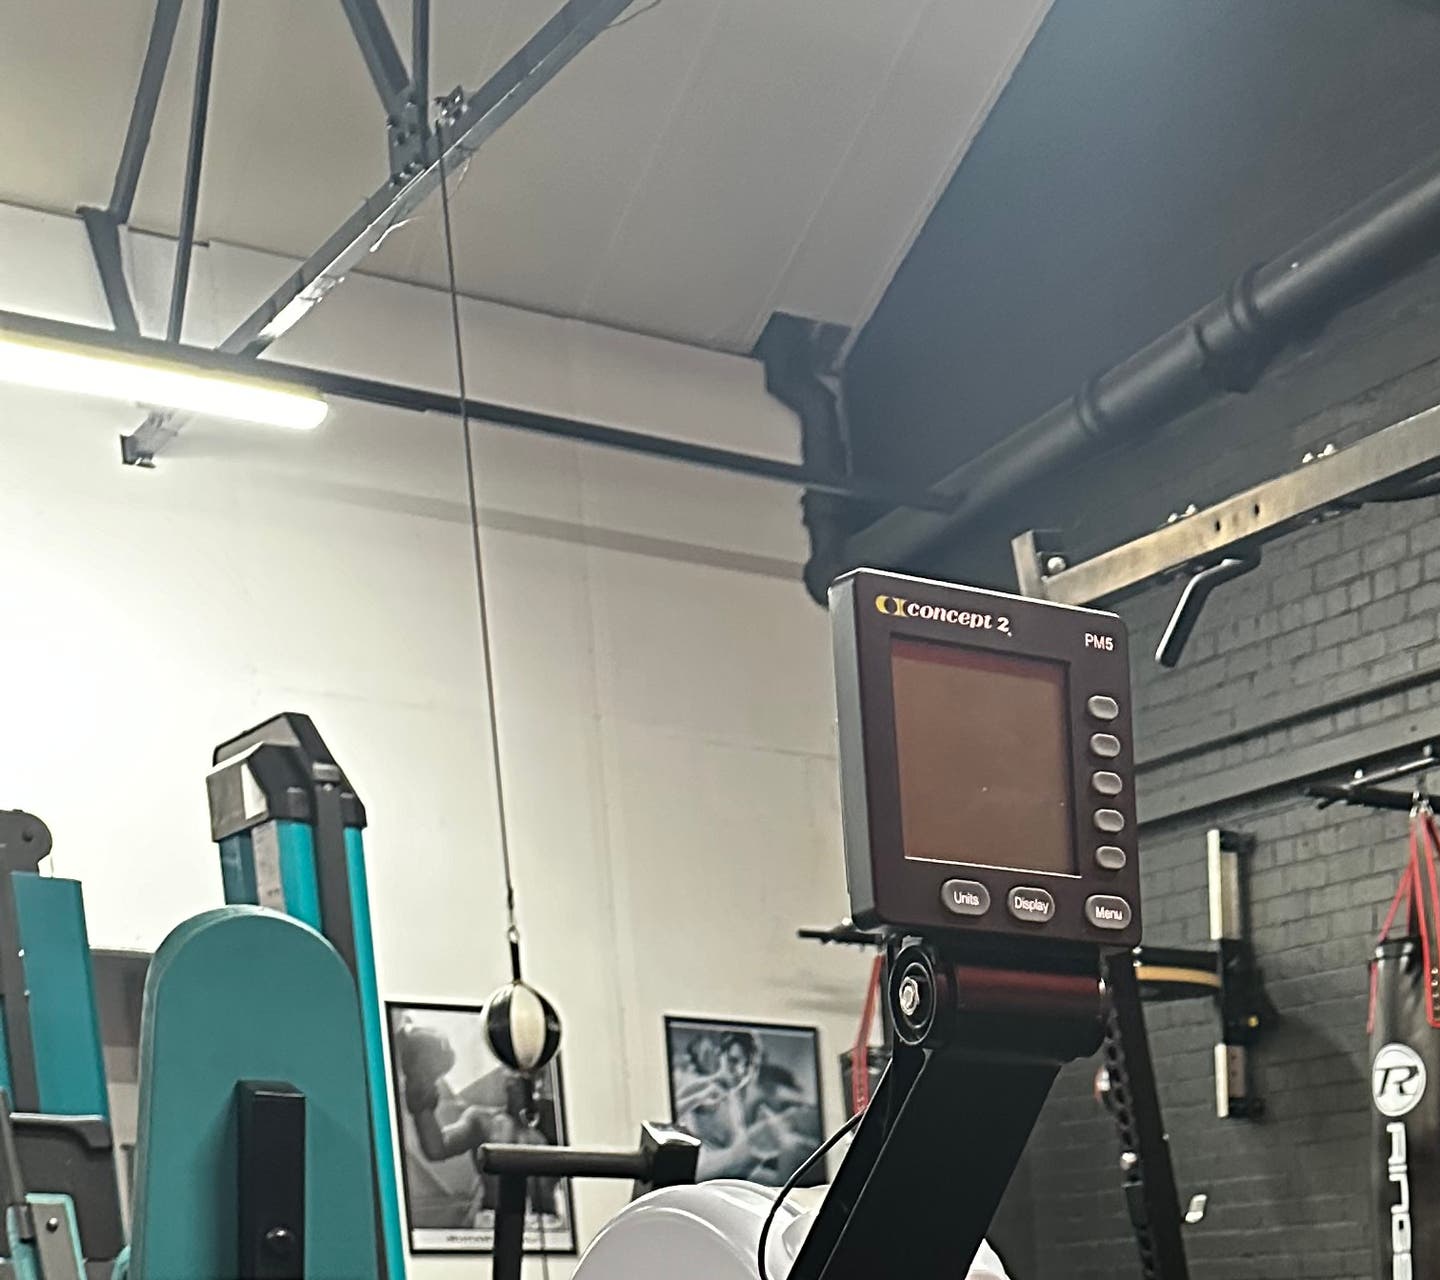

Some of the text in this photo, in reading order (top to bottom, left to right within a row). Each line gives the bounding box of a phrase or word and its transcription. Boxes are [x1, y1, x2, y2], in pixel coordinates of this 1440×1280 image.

[907, 601, 993, 630] concept
[1085, 633, 1114, 651] PM5
[953, 891, 980, 906] Units
[1014, 896, 1049, 914] Display
[1095, 906, 1123, 921] Menu
[1375, 1065, 1421, 1098] R
